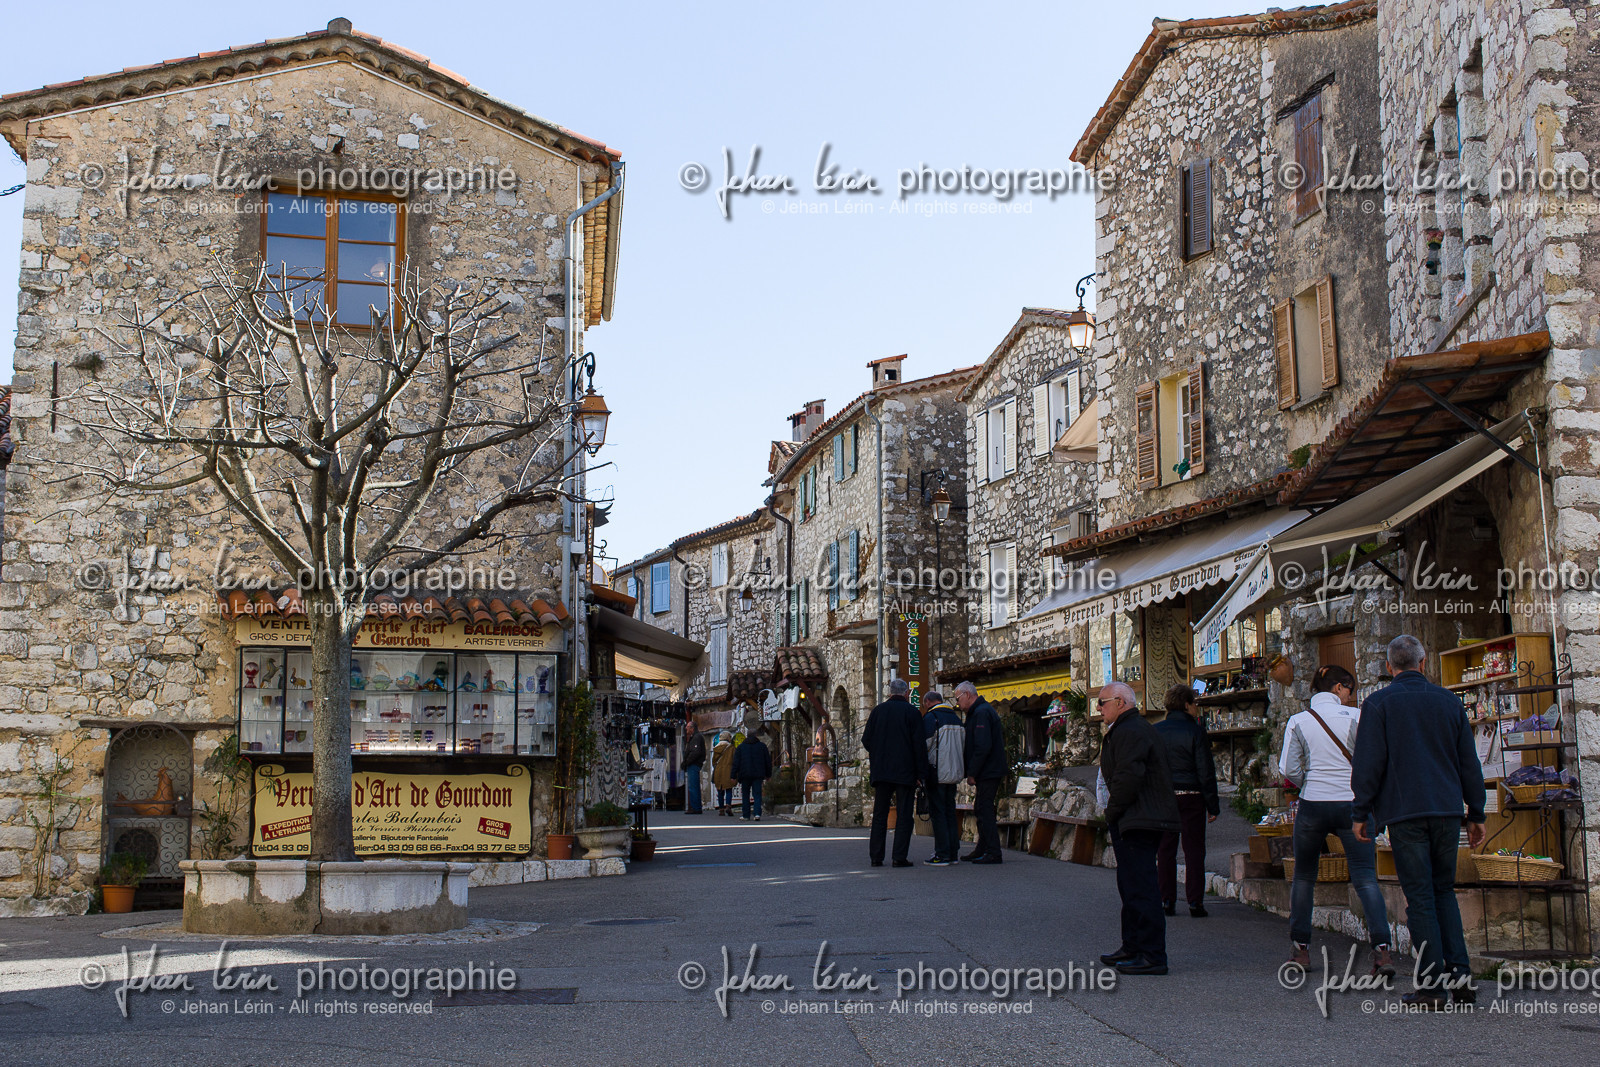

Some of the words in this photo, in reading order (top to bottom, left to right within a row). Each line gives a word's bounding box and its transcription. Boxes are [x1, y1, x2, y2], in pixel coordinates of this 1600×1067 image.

[1063, 600, 1105, 625] Verrerie
[1112, 586, 1143, 610] d'Art
[1150, 583, 1162, 597] de
[1170, 564, 1221, 592] Gourdon
[361, 619, 403, 634] rrerie
[410, 618, 448, 634] d'art
[463, 624, 544, 638] BALEMBOIS
[249, 632, 279, 641] GROS
[285, 633, 312, 642] DETA
[370, 631, 431, 648] Gourdon
[464, 638, 506, 647] ARTISTE
[507, 638, 544, 648] VERRIER
[908, 628, 920, 676] SOURCE
[909, 681, 920, 710] PAR
[275, 777, 314, 808] Verr
[354, 776, 402, 808] d'Art
[409, 780, 430, 808] de
[435, 779, 513, 809] Gourdon
[267, 816, 310, 831] EXPEDITION
[352, 810, 379, 824] rles
[384, 811, 462, 824] Balembois
[485, 819, 504, 829] GROS
[264, 832, 271, 840] A
[272, 823, 312, 838] L'ETRANGE
[381, 834, 415, 843] Bijouterie
[416, 834, 449, 842] Fantaisie
[485, 826, 508, 837] DETAIL
[282, 844, 294, 852] 93
[297, 844, 309, 852] 09
[354, 843, 385, 852] elier:04
[388, 843, 400, 852] 93
[402, 843, 414, 852] 09
[416, 843, 428, 852] 68
[477, 843, 489, 852] 93
[491, 843, 503, 852] 77
[505, 843, 517, 852] 62
[518, 843, 531, 852] 55
